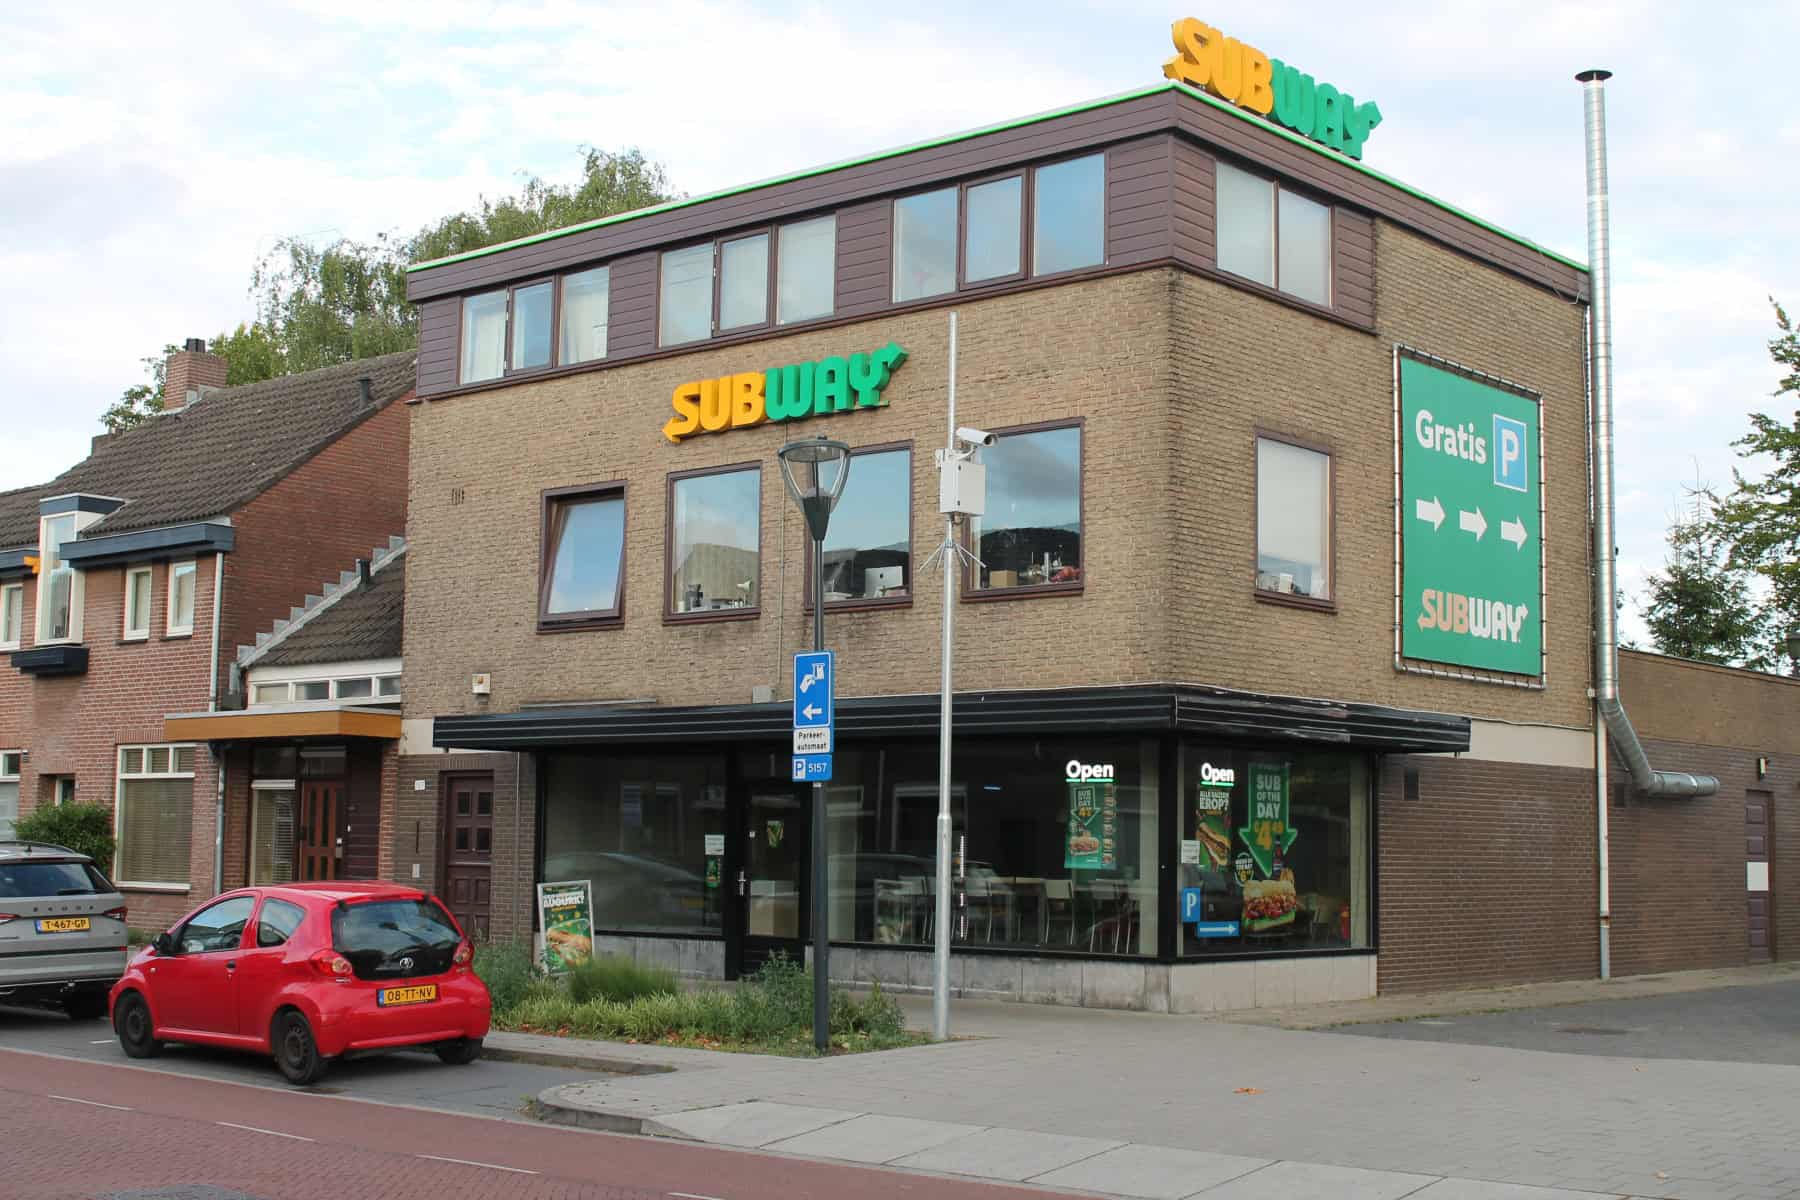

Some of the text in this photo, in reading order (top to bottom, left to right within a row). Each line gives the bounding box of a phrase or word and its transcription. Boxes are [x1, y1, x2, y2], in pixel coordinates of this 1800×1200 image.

[1162, 17, 1383, 160] SUBWAY
[662, 342, 909, 443] SUBWAY
[1416, 410, 1520, 477] Gratis P
[1418, 589, 1528, 642] SUBWAY
[795, 760, 827, 777] P 5157
[1066, 760, 1114, 782] Open
[1201, 762, 1235, 786] Open
[1256, 774, 1280, 790] SUB
[1256, 792, 1280, 801] OF THE
[1257, 803, 1280, 819] DAY
[1186, 892, 1197, 917] P
[387, 986, 433, 1001] 08-TT-NV
